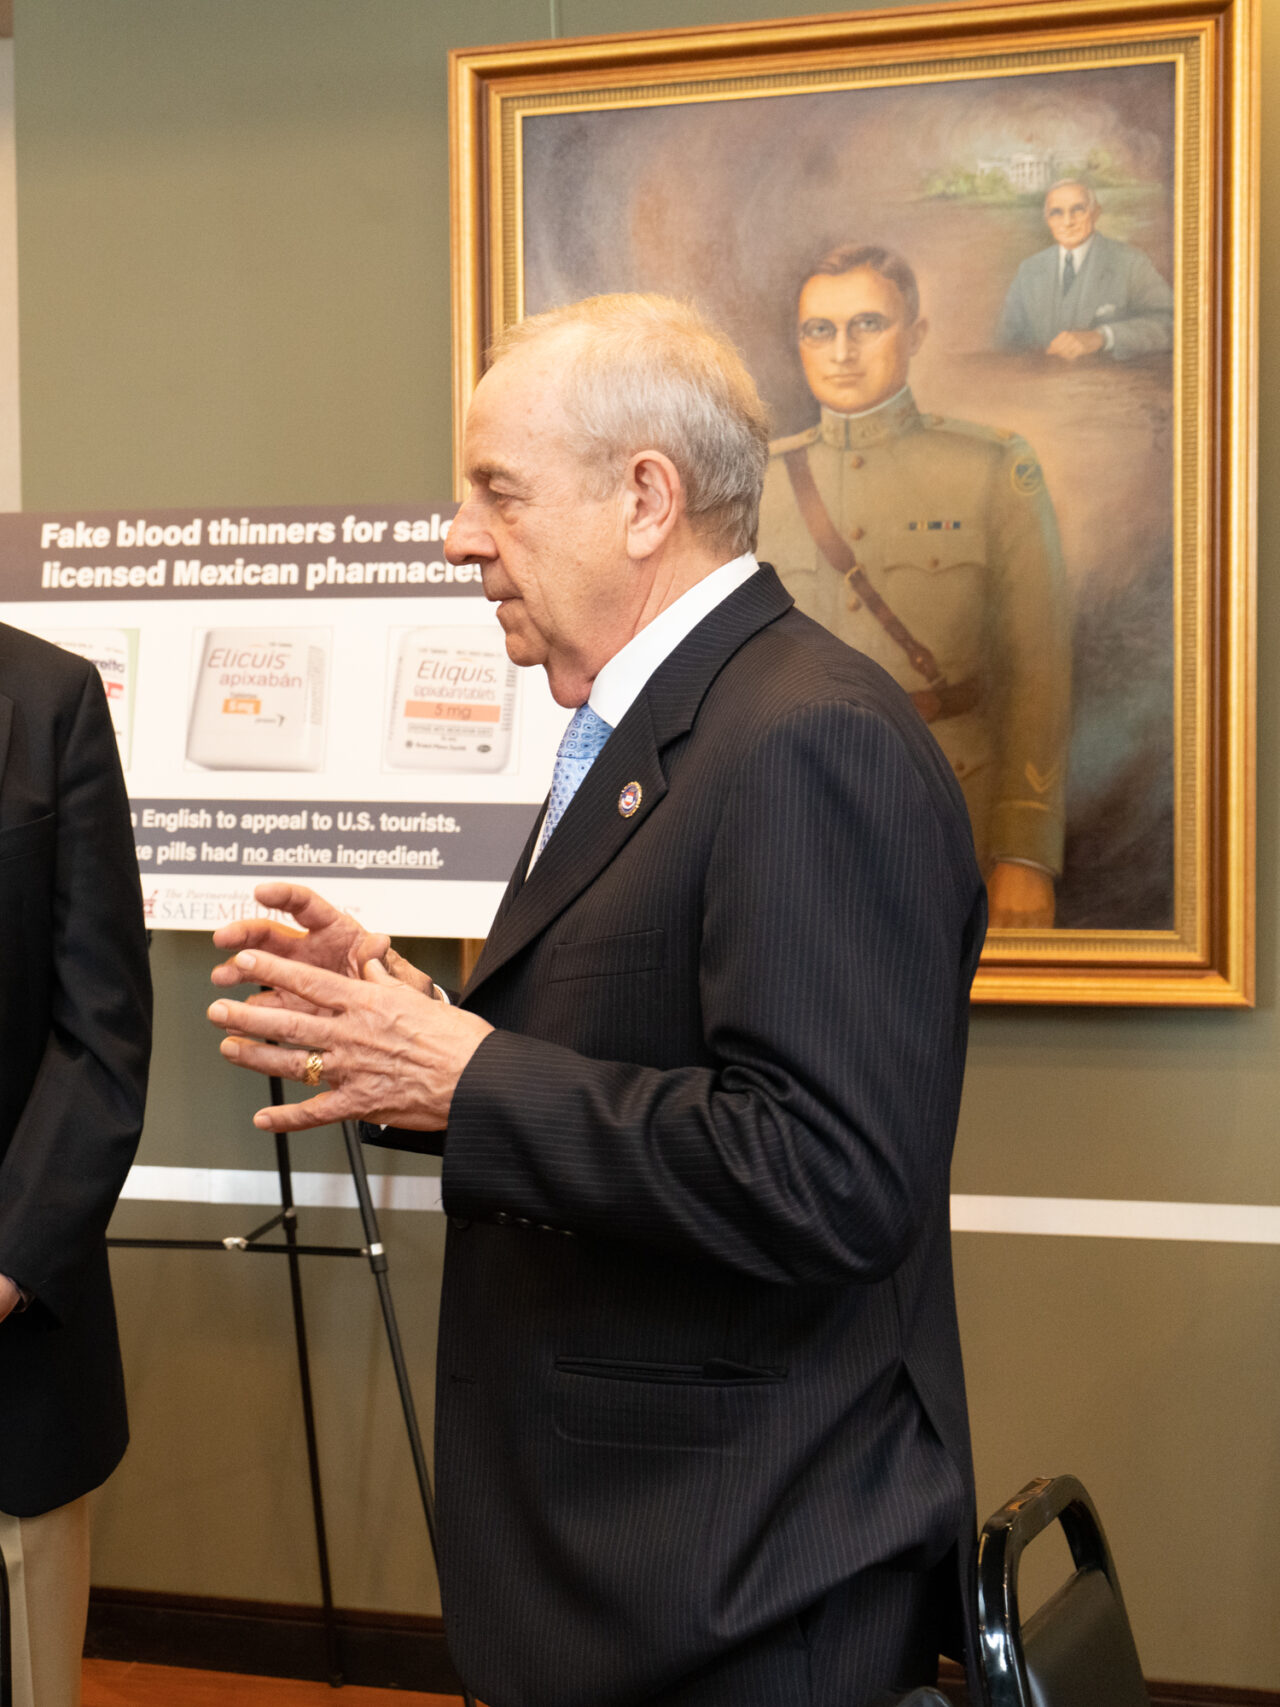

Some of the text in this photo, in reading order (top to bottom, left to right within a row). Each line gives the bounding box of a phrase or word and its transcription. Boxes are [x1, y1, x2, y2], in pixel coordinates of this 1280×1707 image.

[41, 521, 111, 549] Fake
[116, 518, 203, 547] blood
[207, 516, 336, 545] thinners
[341, 514, 388, 543] for
[41, 560, 167, 588] licensed
[172, 557, 299, 586] Mexican
[207, 648, 290, 670] Elicuis
[434, 703, 472, 721] 5 mg
[142, 808, 212, 833] English
[216, 810, 237, 829] to
[240, 810, 308, 834] appeal
[311, 811, 333, 831] to
[337, 811, 375, 832] U.S.
[379, 812, 461, 833] tourists.
[156, 841, 197, 866] pills
[200, 842, 238, 862] had
[241, 846, 269, 864] no
[272, 843, 332, 865] active
[336, 844, 444, 870] ingredient.
